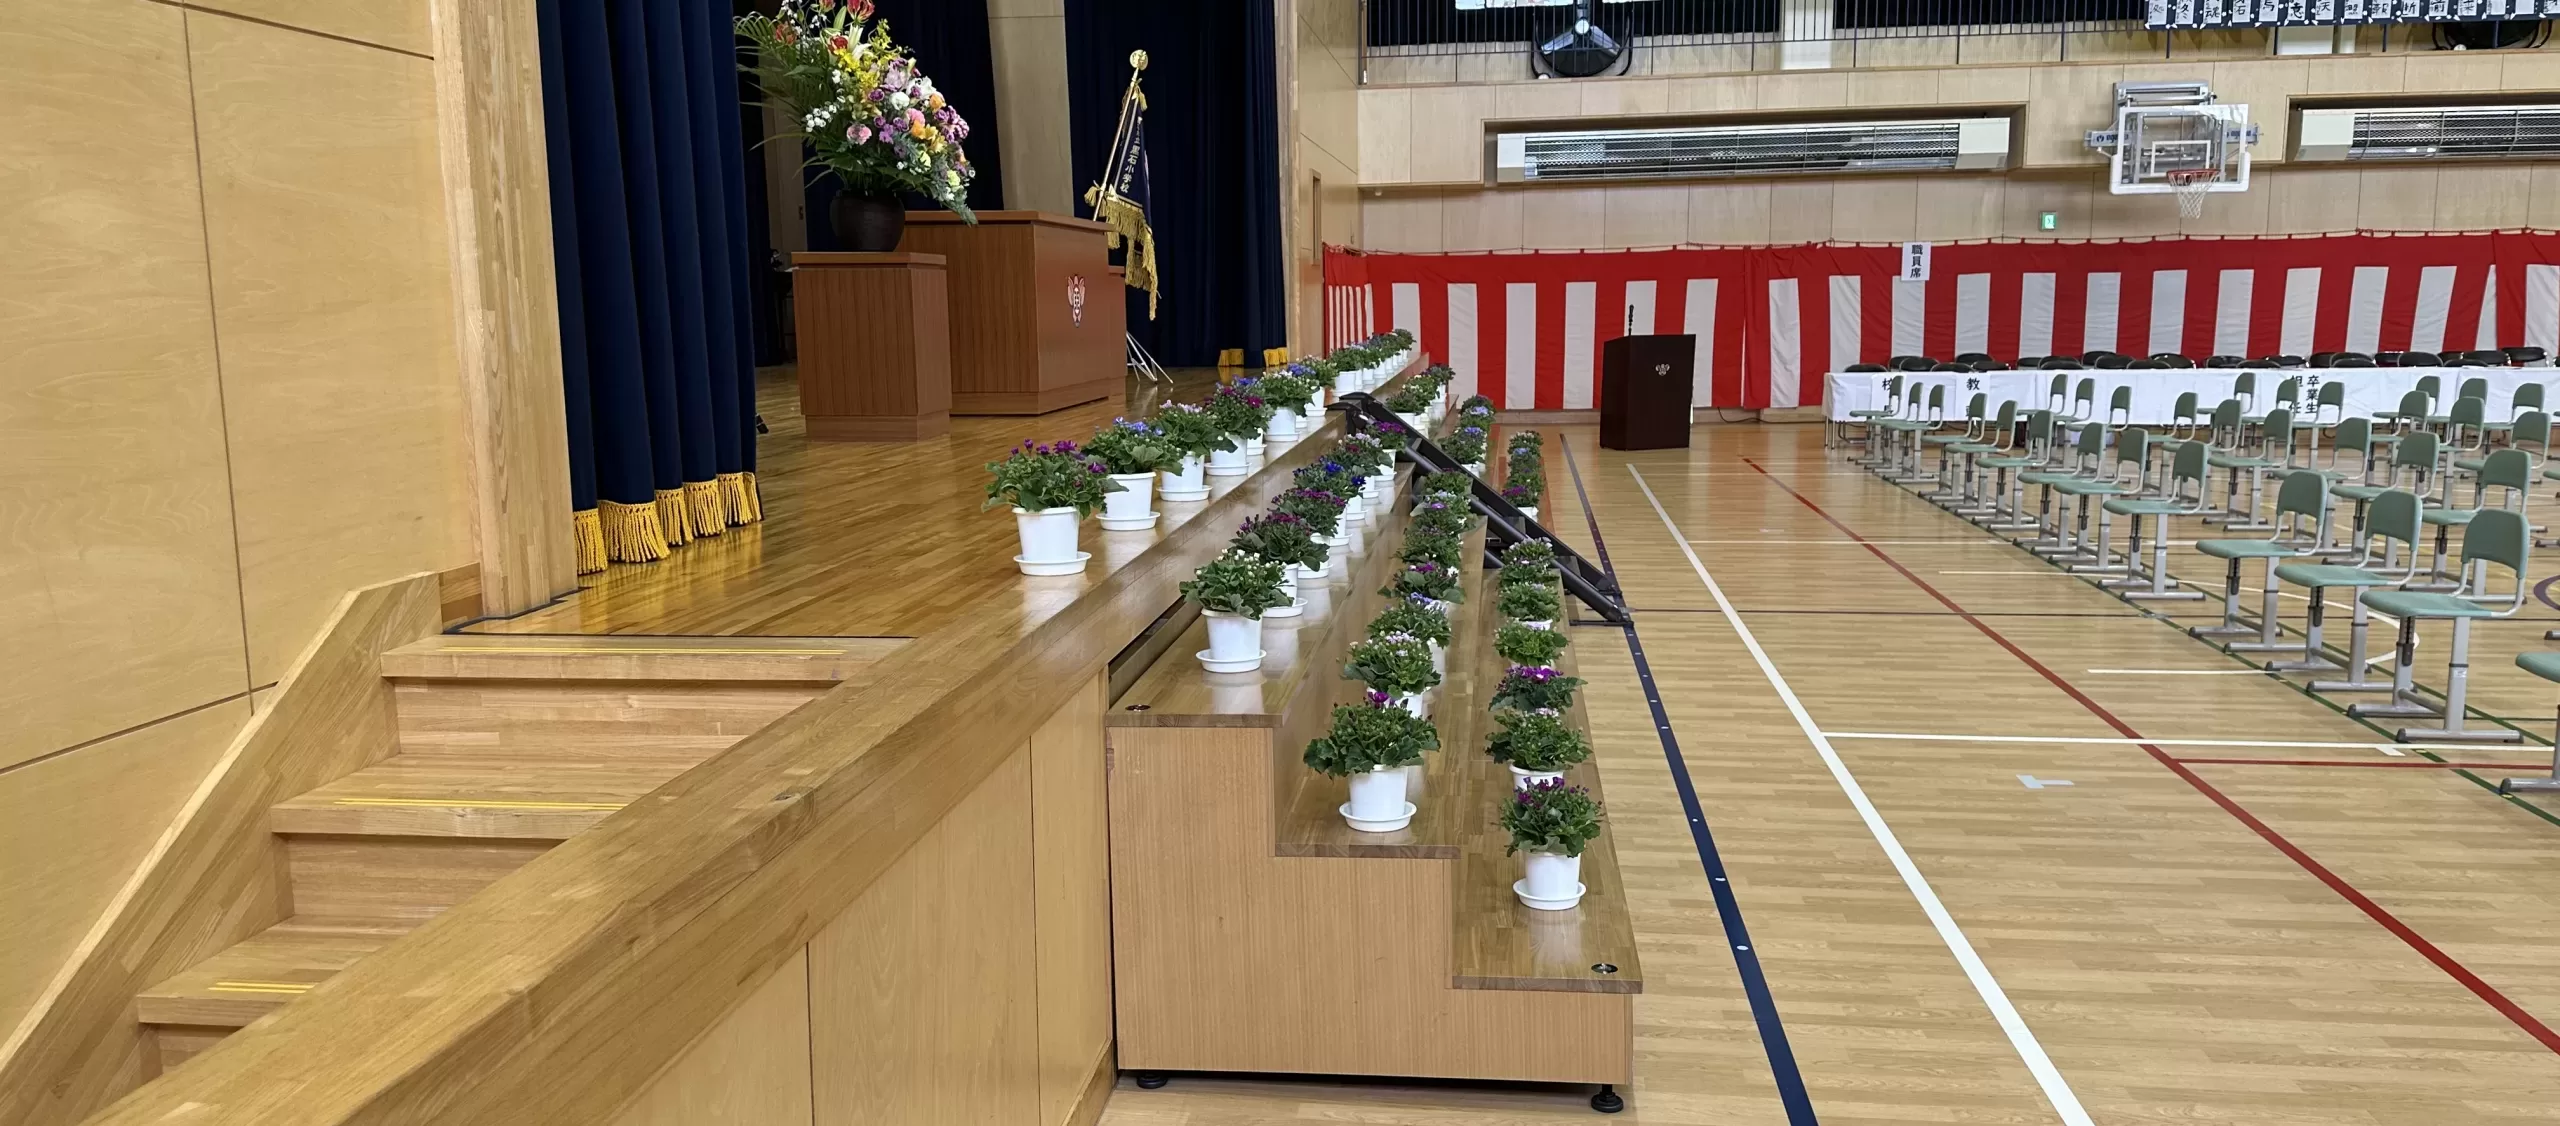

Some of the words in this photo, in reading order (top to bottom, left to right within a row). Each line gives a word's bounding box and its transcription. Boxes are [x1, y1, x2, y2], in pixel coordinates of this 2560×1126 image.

[2181, 0, 2190, 19] 冬
[1910, 244, 1923, 278] 職員席
[2305, 375, 2320, 414] 卒業生
